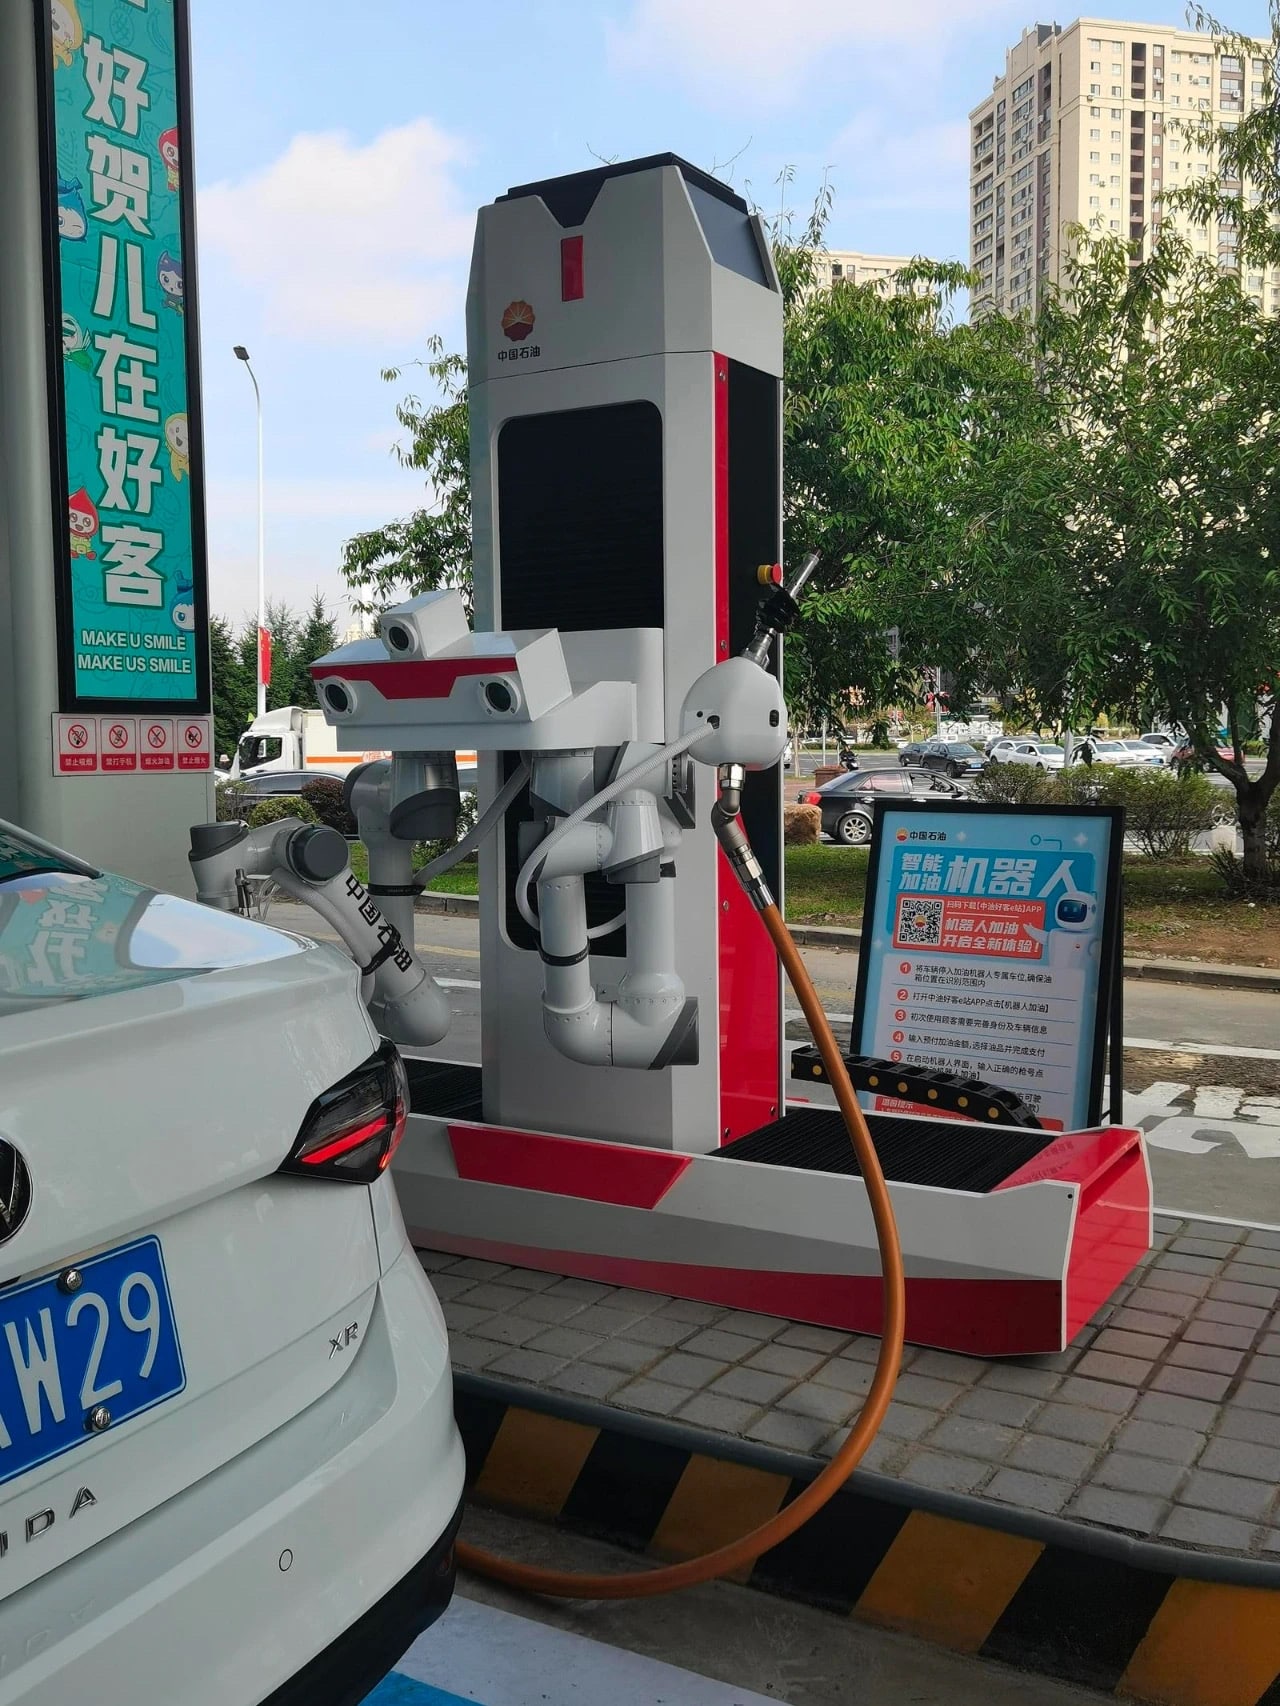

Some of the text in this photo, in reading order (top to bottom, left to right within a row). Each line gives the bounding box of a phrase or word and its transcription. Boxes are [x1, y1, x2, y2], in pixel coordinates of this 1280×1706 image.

[83, 0, 163, 606] 好贺儿在好客
[497, 345, 541, 361] 中国石油
[82, 630, 186, 650] MAKE U SMILE
[78, 654, 191, 674] MAKE US SMILE
[909, 831, 947, 842] 中国石油
[901, 853, 944, 872] 智能
[898, 872, 942, 891] 加油
[943, 855, 1078, 898] 机器人
[945, 918, 1019, 935] 机器人加油
[329, 1321, 358, 1359] XR
[0, 1271, 160, 1449] W29
